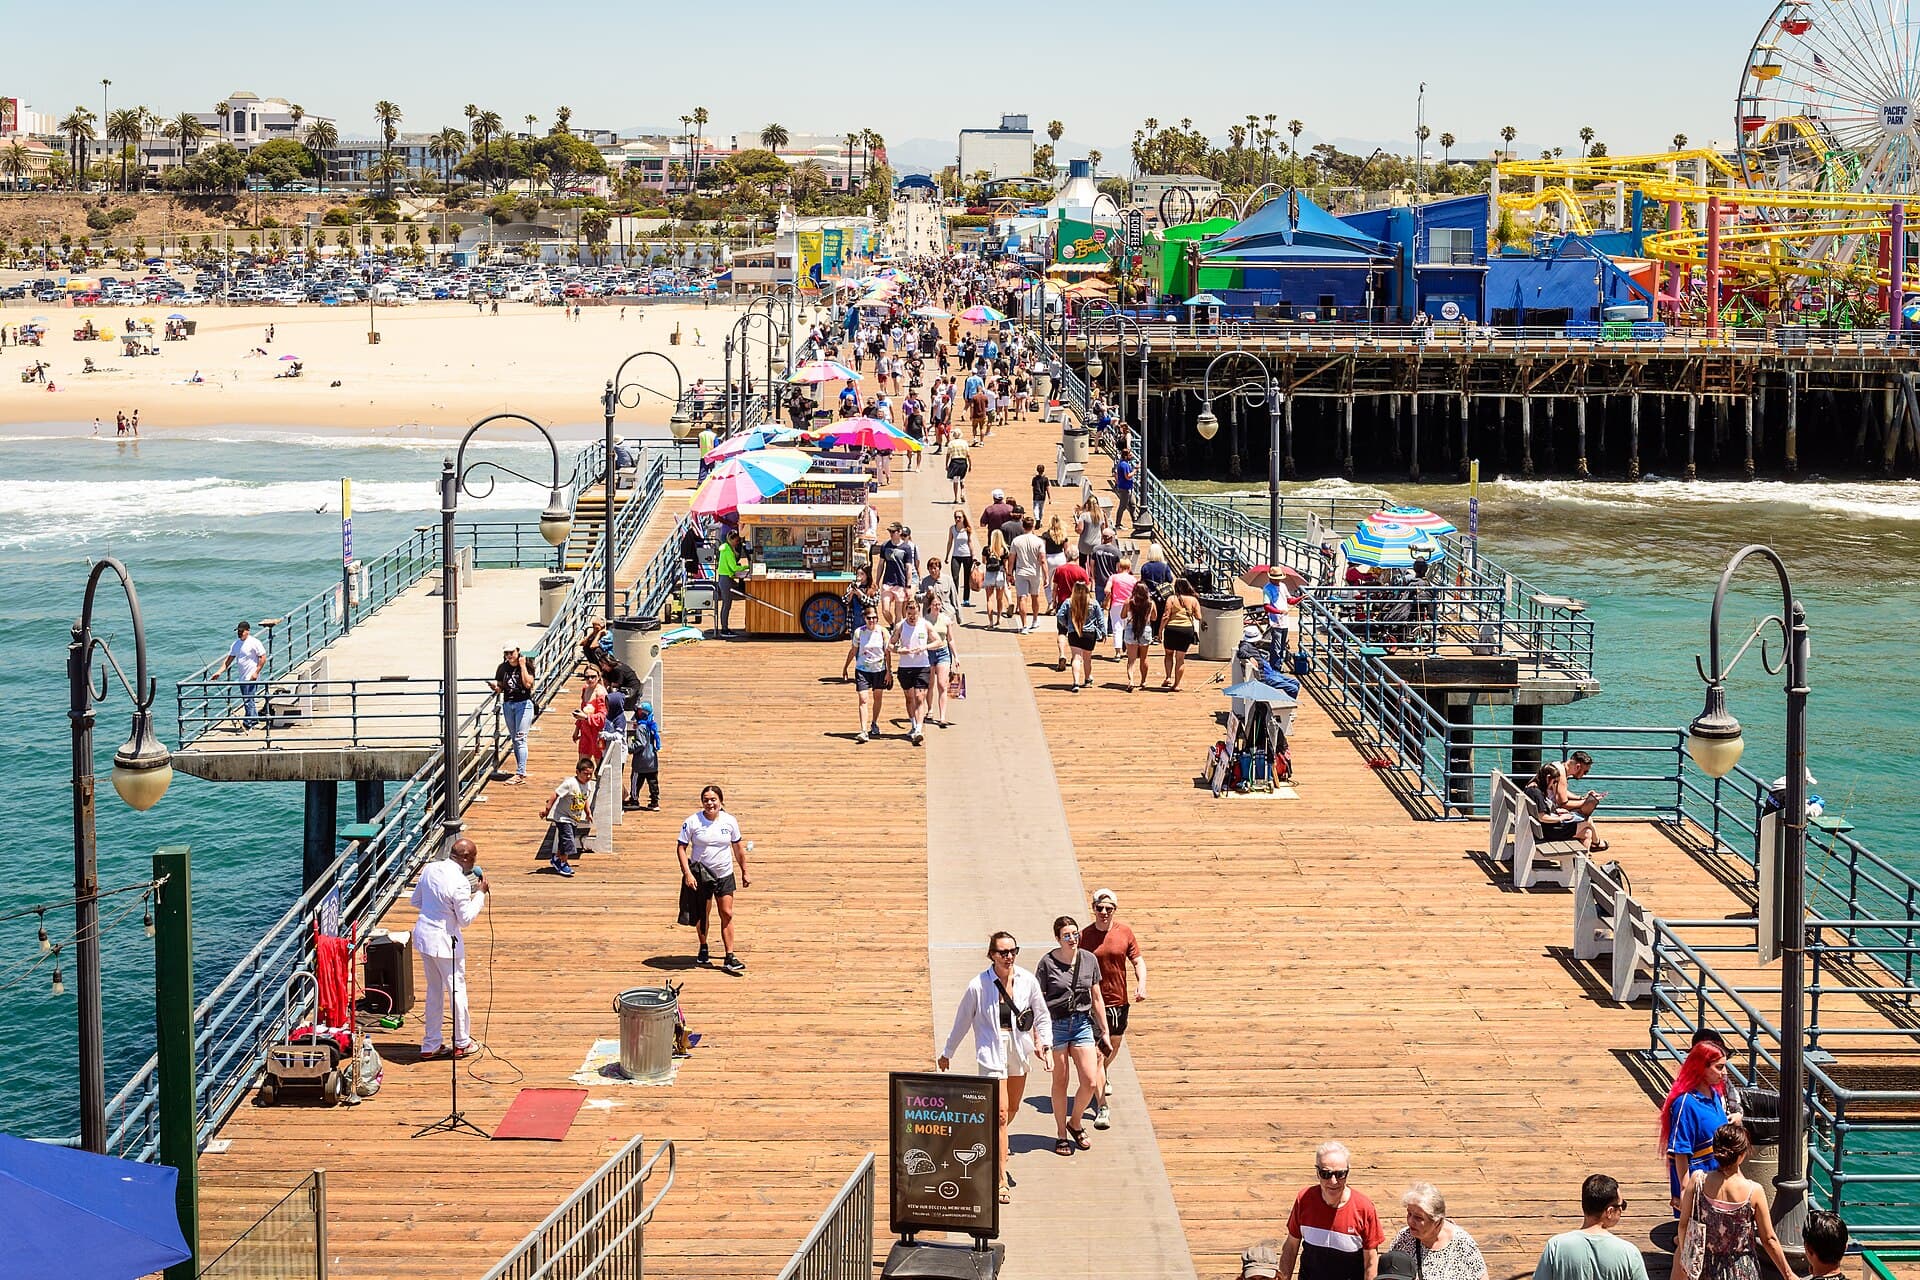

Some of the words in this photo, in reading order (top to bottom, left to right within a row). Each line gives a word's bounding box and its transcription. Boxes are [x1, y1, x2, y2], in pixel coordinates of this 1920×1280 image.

[1884, 106, 1908, 116] PACIFIC
[1887, 116, 1904, 125] PARK
[1130, 219, 1140, 246] COFFEE
[905, 1096, 948, 1110] TACOS,
[904, 1109, 985, 1124] MARGARITAS
[905, 1123, 912, 1133] &
[914, 1124, 952, 1136] MORE!
